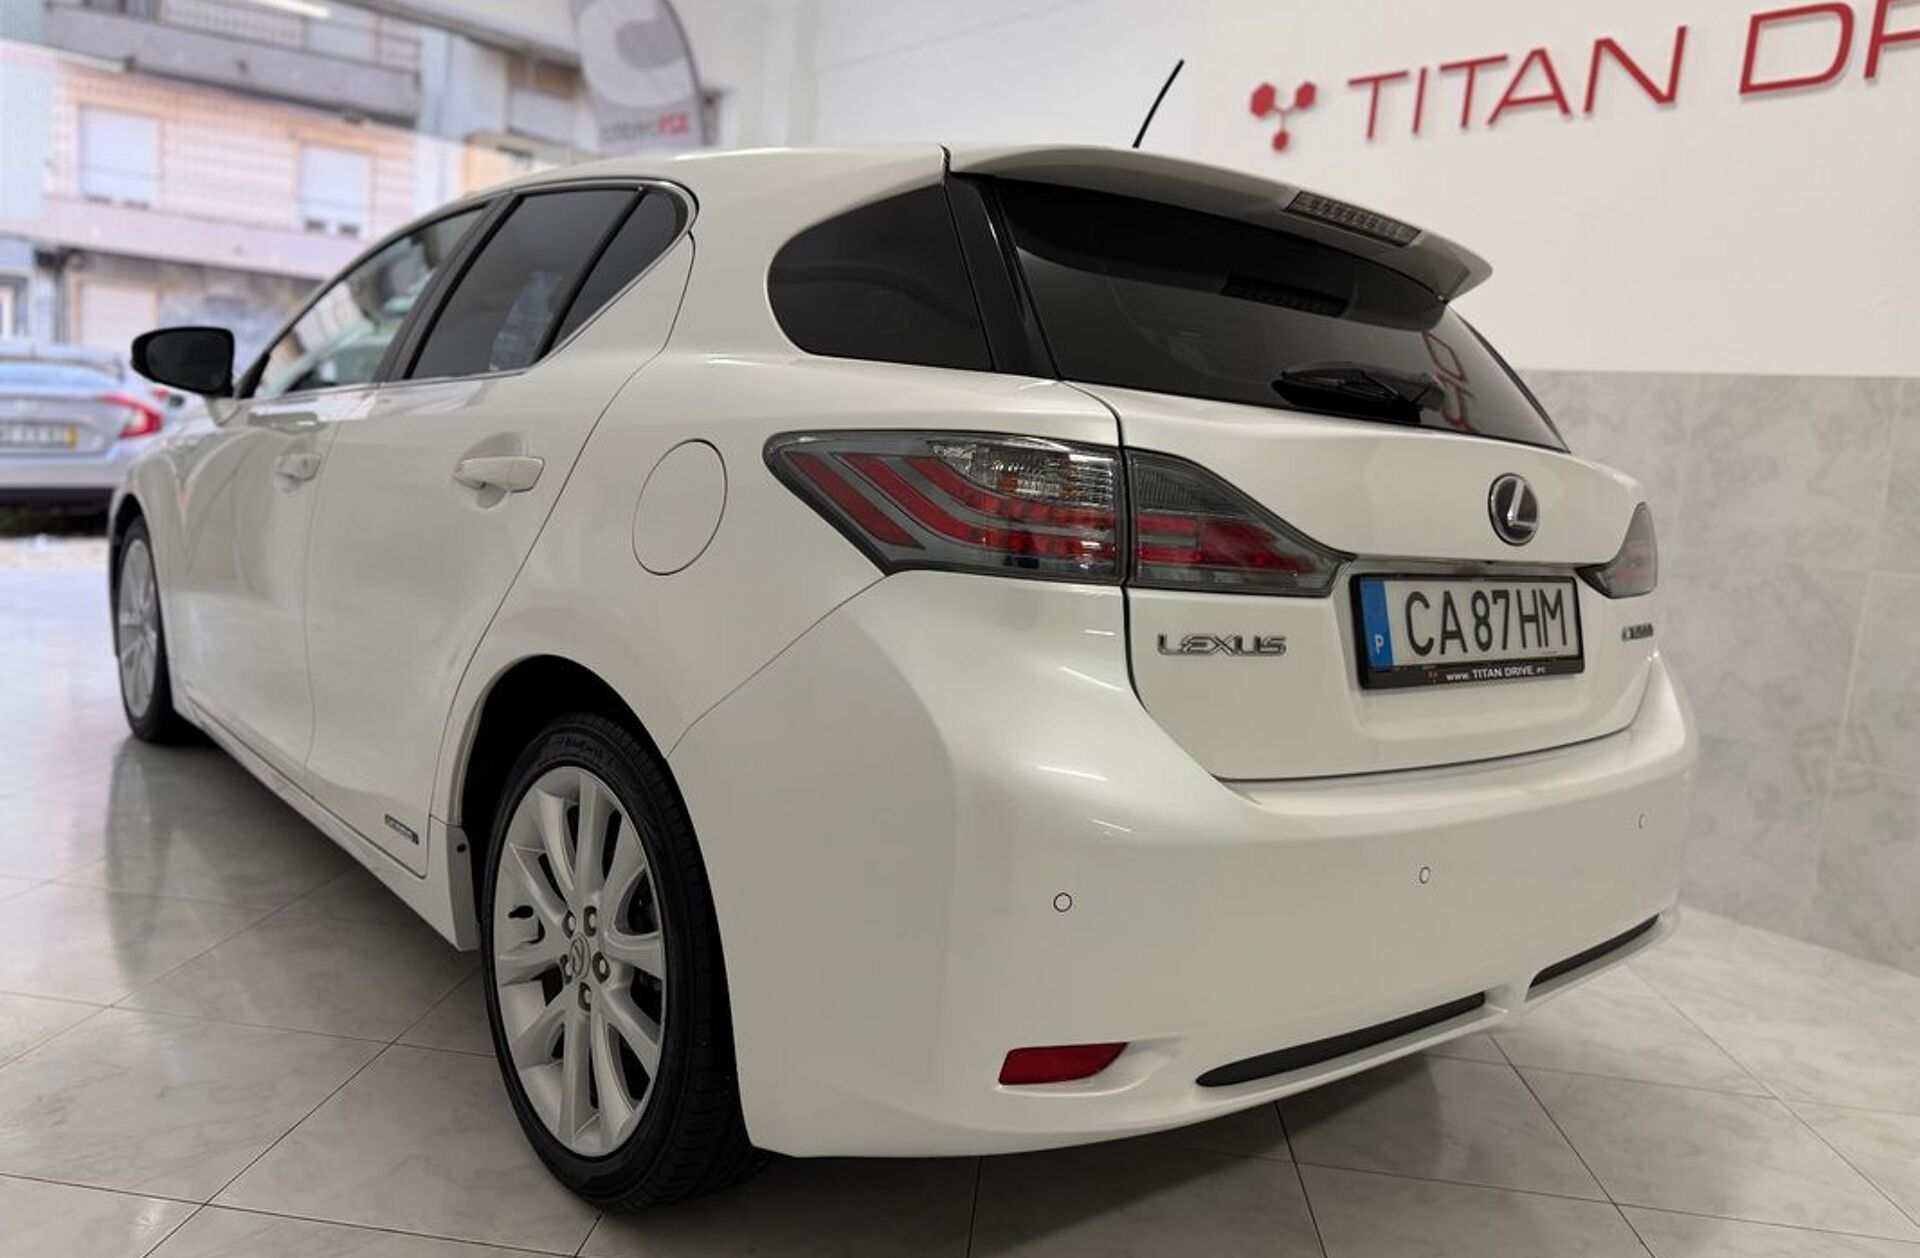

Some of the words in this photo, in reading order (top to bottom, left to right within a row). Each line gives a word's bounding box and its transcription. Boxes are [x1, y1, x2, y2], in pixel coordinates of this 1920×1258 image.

[1347, 25, 1688, 141] TITAN
[1157, 633, 1287, 656] LEXUS
[1472, 668, 1503, 679] TITAN
[1504, 665, 1534, 677] DRIVE
